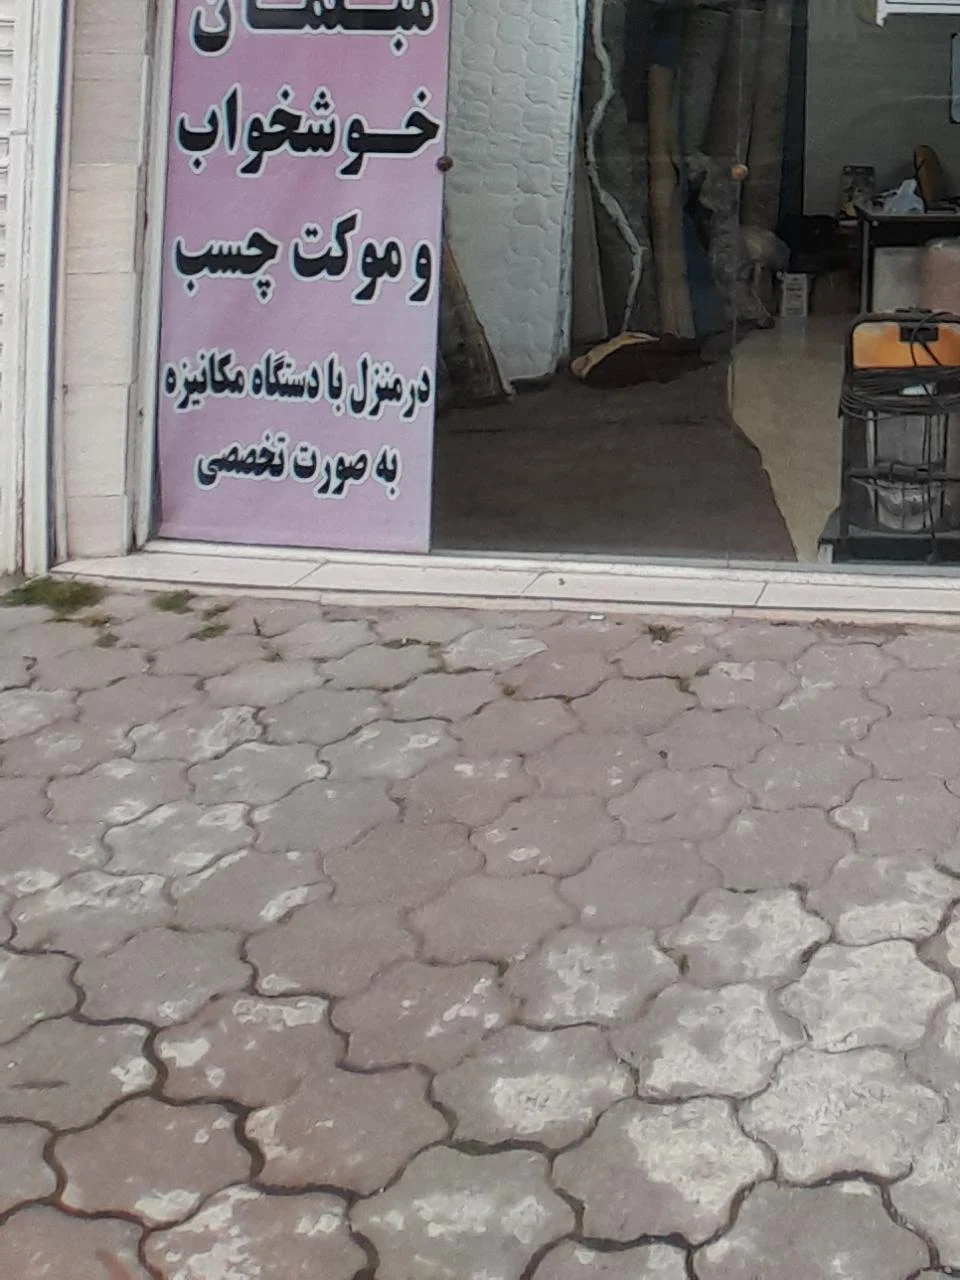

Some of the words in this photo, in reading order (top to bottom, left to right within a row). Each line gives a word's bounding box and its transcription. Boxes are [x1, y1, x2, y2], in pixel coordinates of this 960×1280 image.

[176, 82, 444, 179] خوشخواب
[174, 227, 281, 303] چسب
[289, 209, 401, 304] موکت
[406, 239, 433, 305] و
[164, 349, 246, 412] مکانیزه
[251, 349, 320, 401] دستگاه
[326, 353, 346, 413] با
[349, 352, 403, 419] منزل
[400, 366, 432, 419] در
[196, 431, 285, 489] تخصصی
[291, 441, 369, 498] صورت
[373, 444, 399, 500] به
